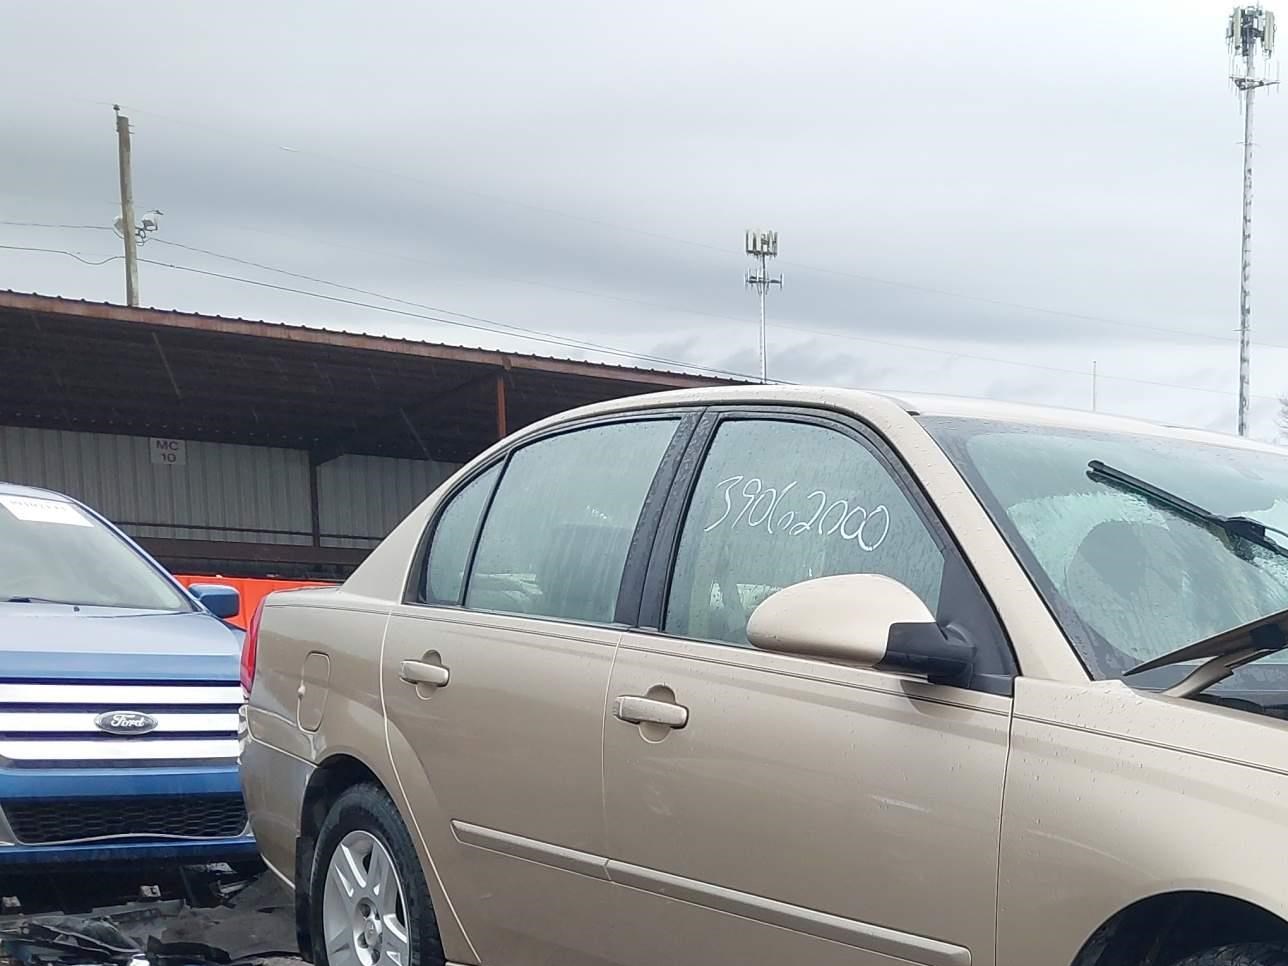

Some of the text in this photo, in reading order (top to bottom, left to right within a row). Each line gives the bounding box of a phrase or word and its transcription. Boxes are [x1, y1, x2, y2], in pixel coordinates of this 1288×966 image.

[156, 440, 178, 450] MC
[161, 453, 176, 462] 10
[704, 475, 890, 551] 39062000
[110, 714, 145, 727] Ford
